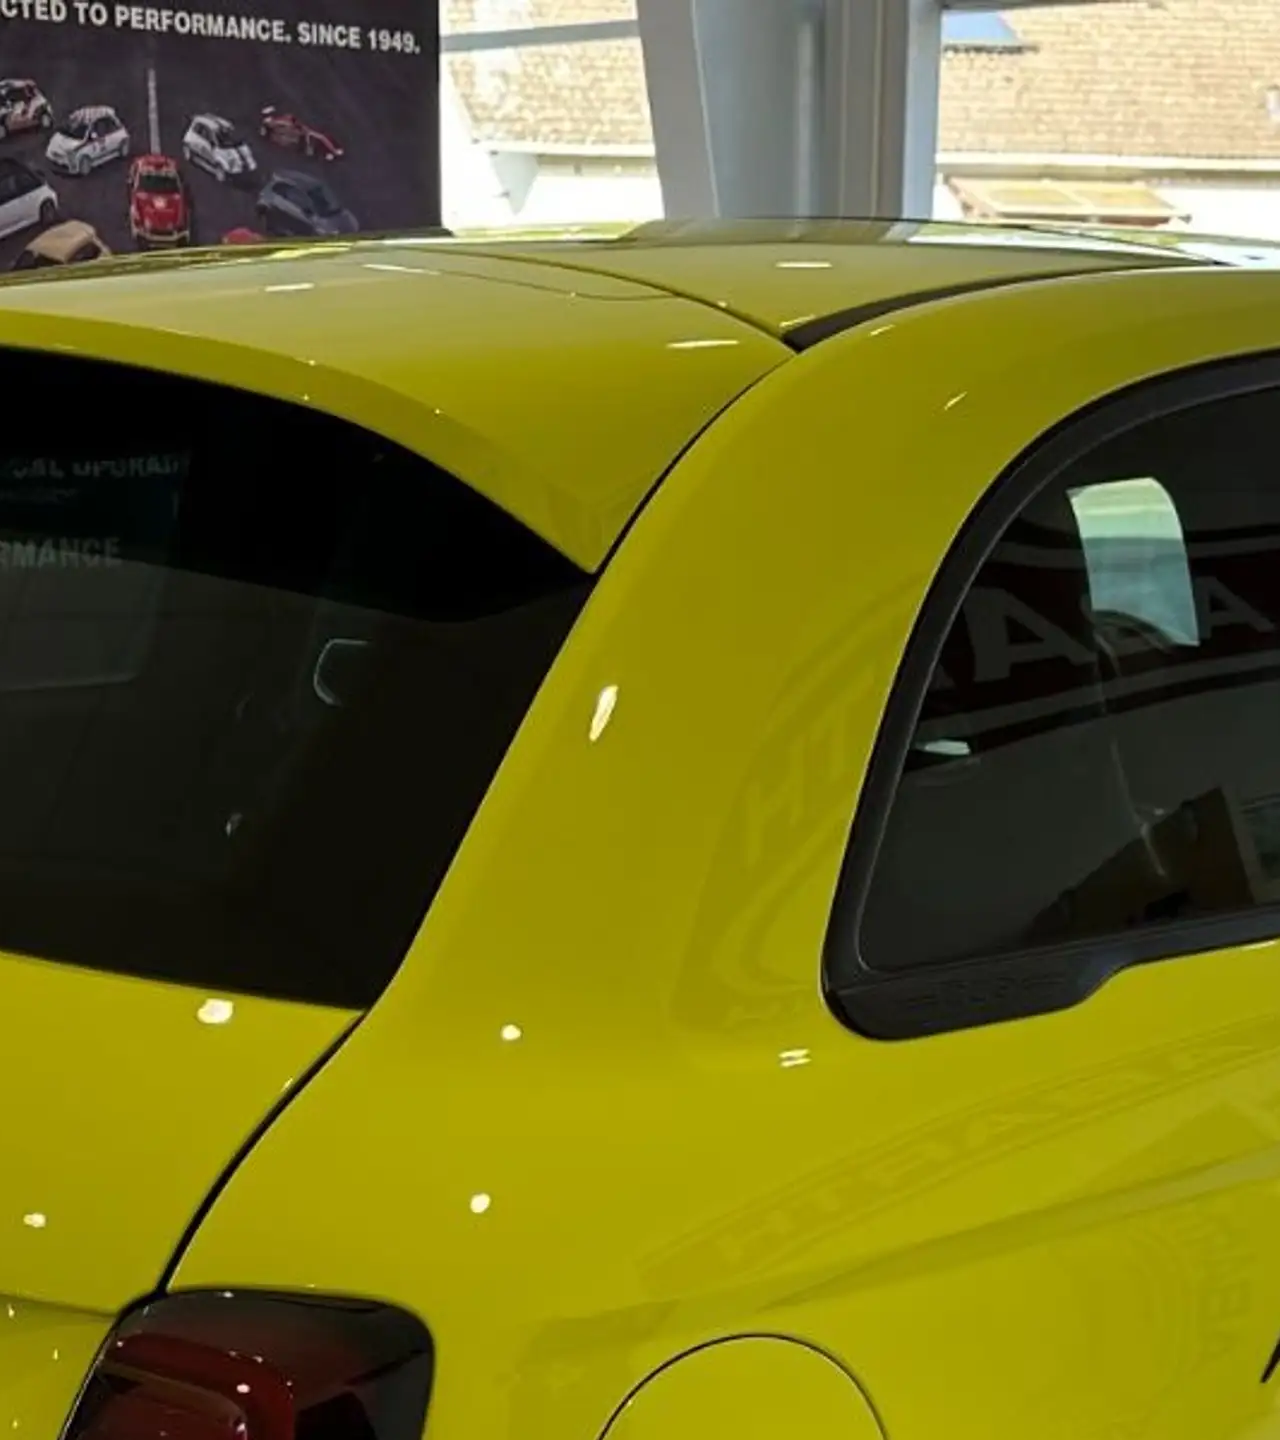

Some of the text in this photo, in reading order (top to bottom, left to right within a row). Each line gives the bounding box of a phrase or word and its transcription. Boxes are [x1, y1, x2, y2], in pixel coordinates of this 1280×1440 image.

[74, 3, 108, 26] TO
[115, 6, 292, 43] PERFORMANCE.
[297, 22, 361, 49] SINCE
[367, 29, 421, 54] 1949.
